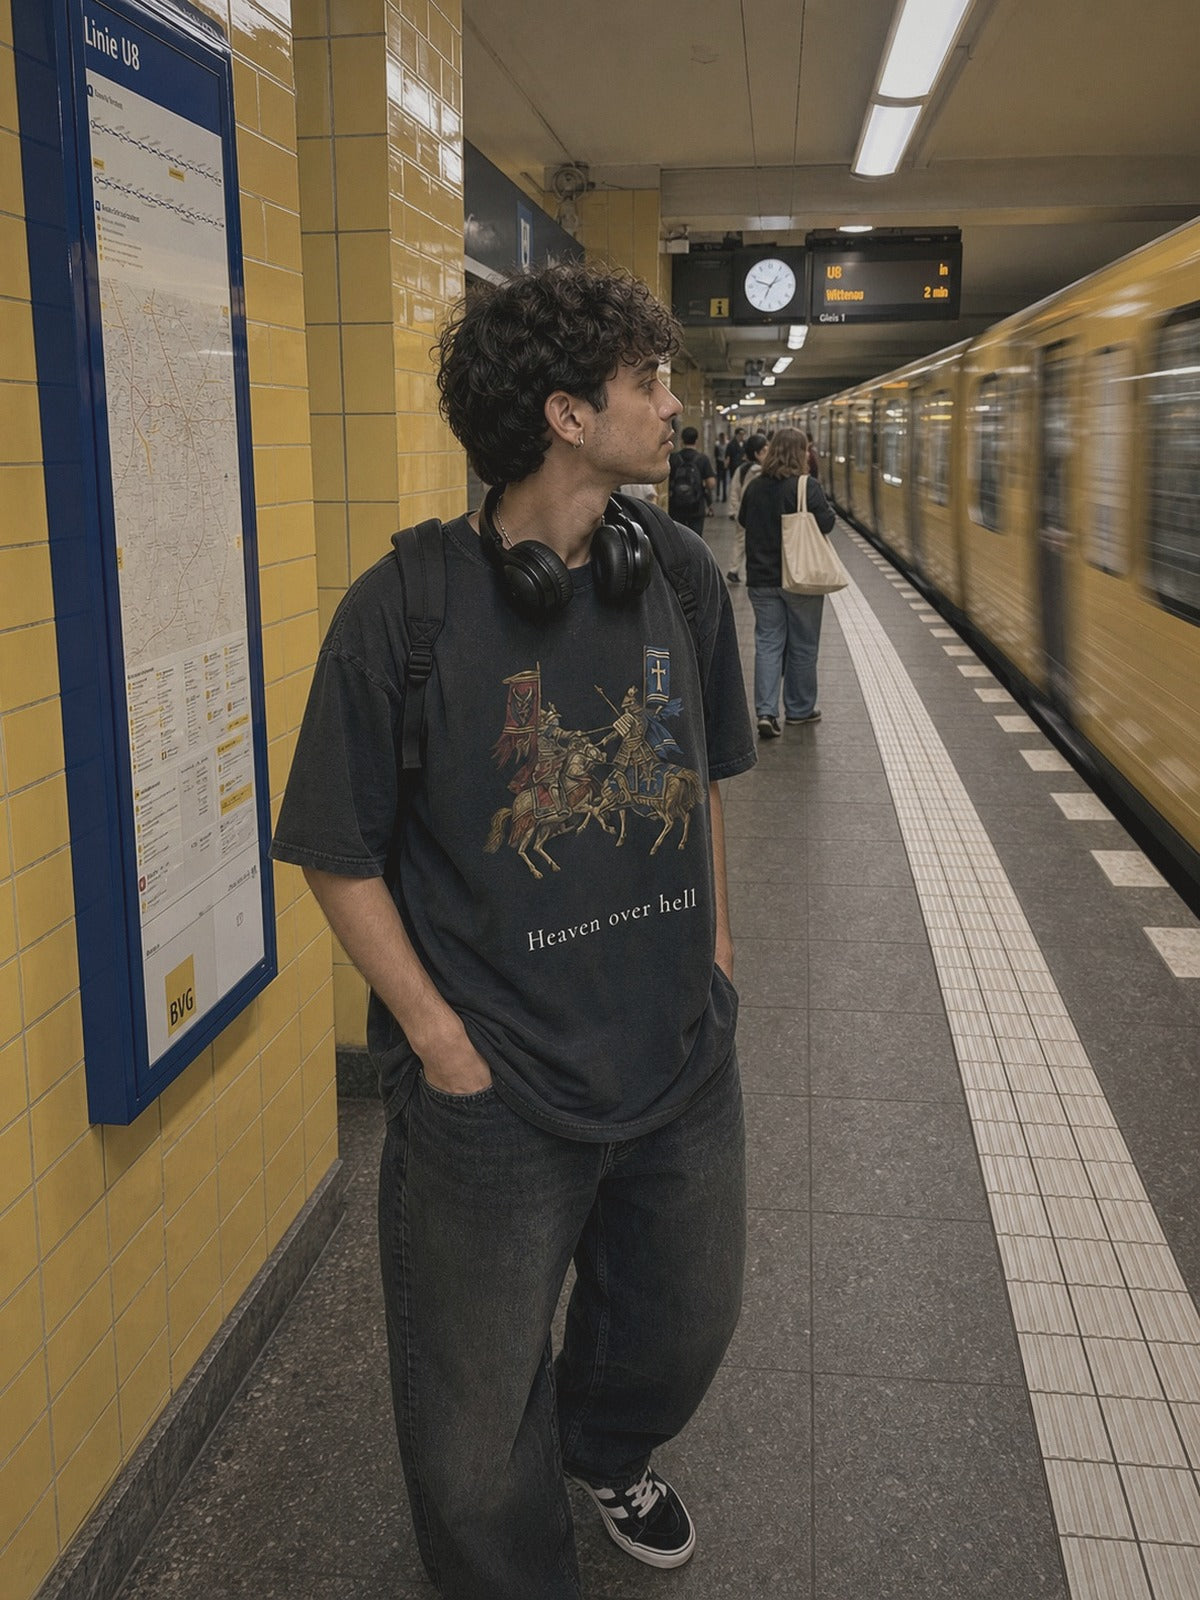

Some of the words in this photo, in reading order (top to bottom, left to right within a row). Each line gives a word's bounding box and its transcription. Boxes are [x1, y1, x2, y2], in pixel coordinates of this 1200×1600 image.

[84, 15, 118, 59] Linie
[121, 36, 140, 71] U8
[826, 265, 842, 279] U8
[939, 263, 948, 276] in
[923, 286, 931, 299] 2
[932, 286, 948, 298] min
[819, 313, 839, 322] Gleis
[841, 313, 846, 322] 1
[527, 918, 600, 951] Heaven
[608, 903, 651, 927] over
[659, 888, 697, 914] hell
[170, 987, 193, 1026] BVG
